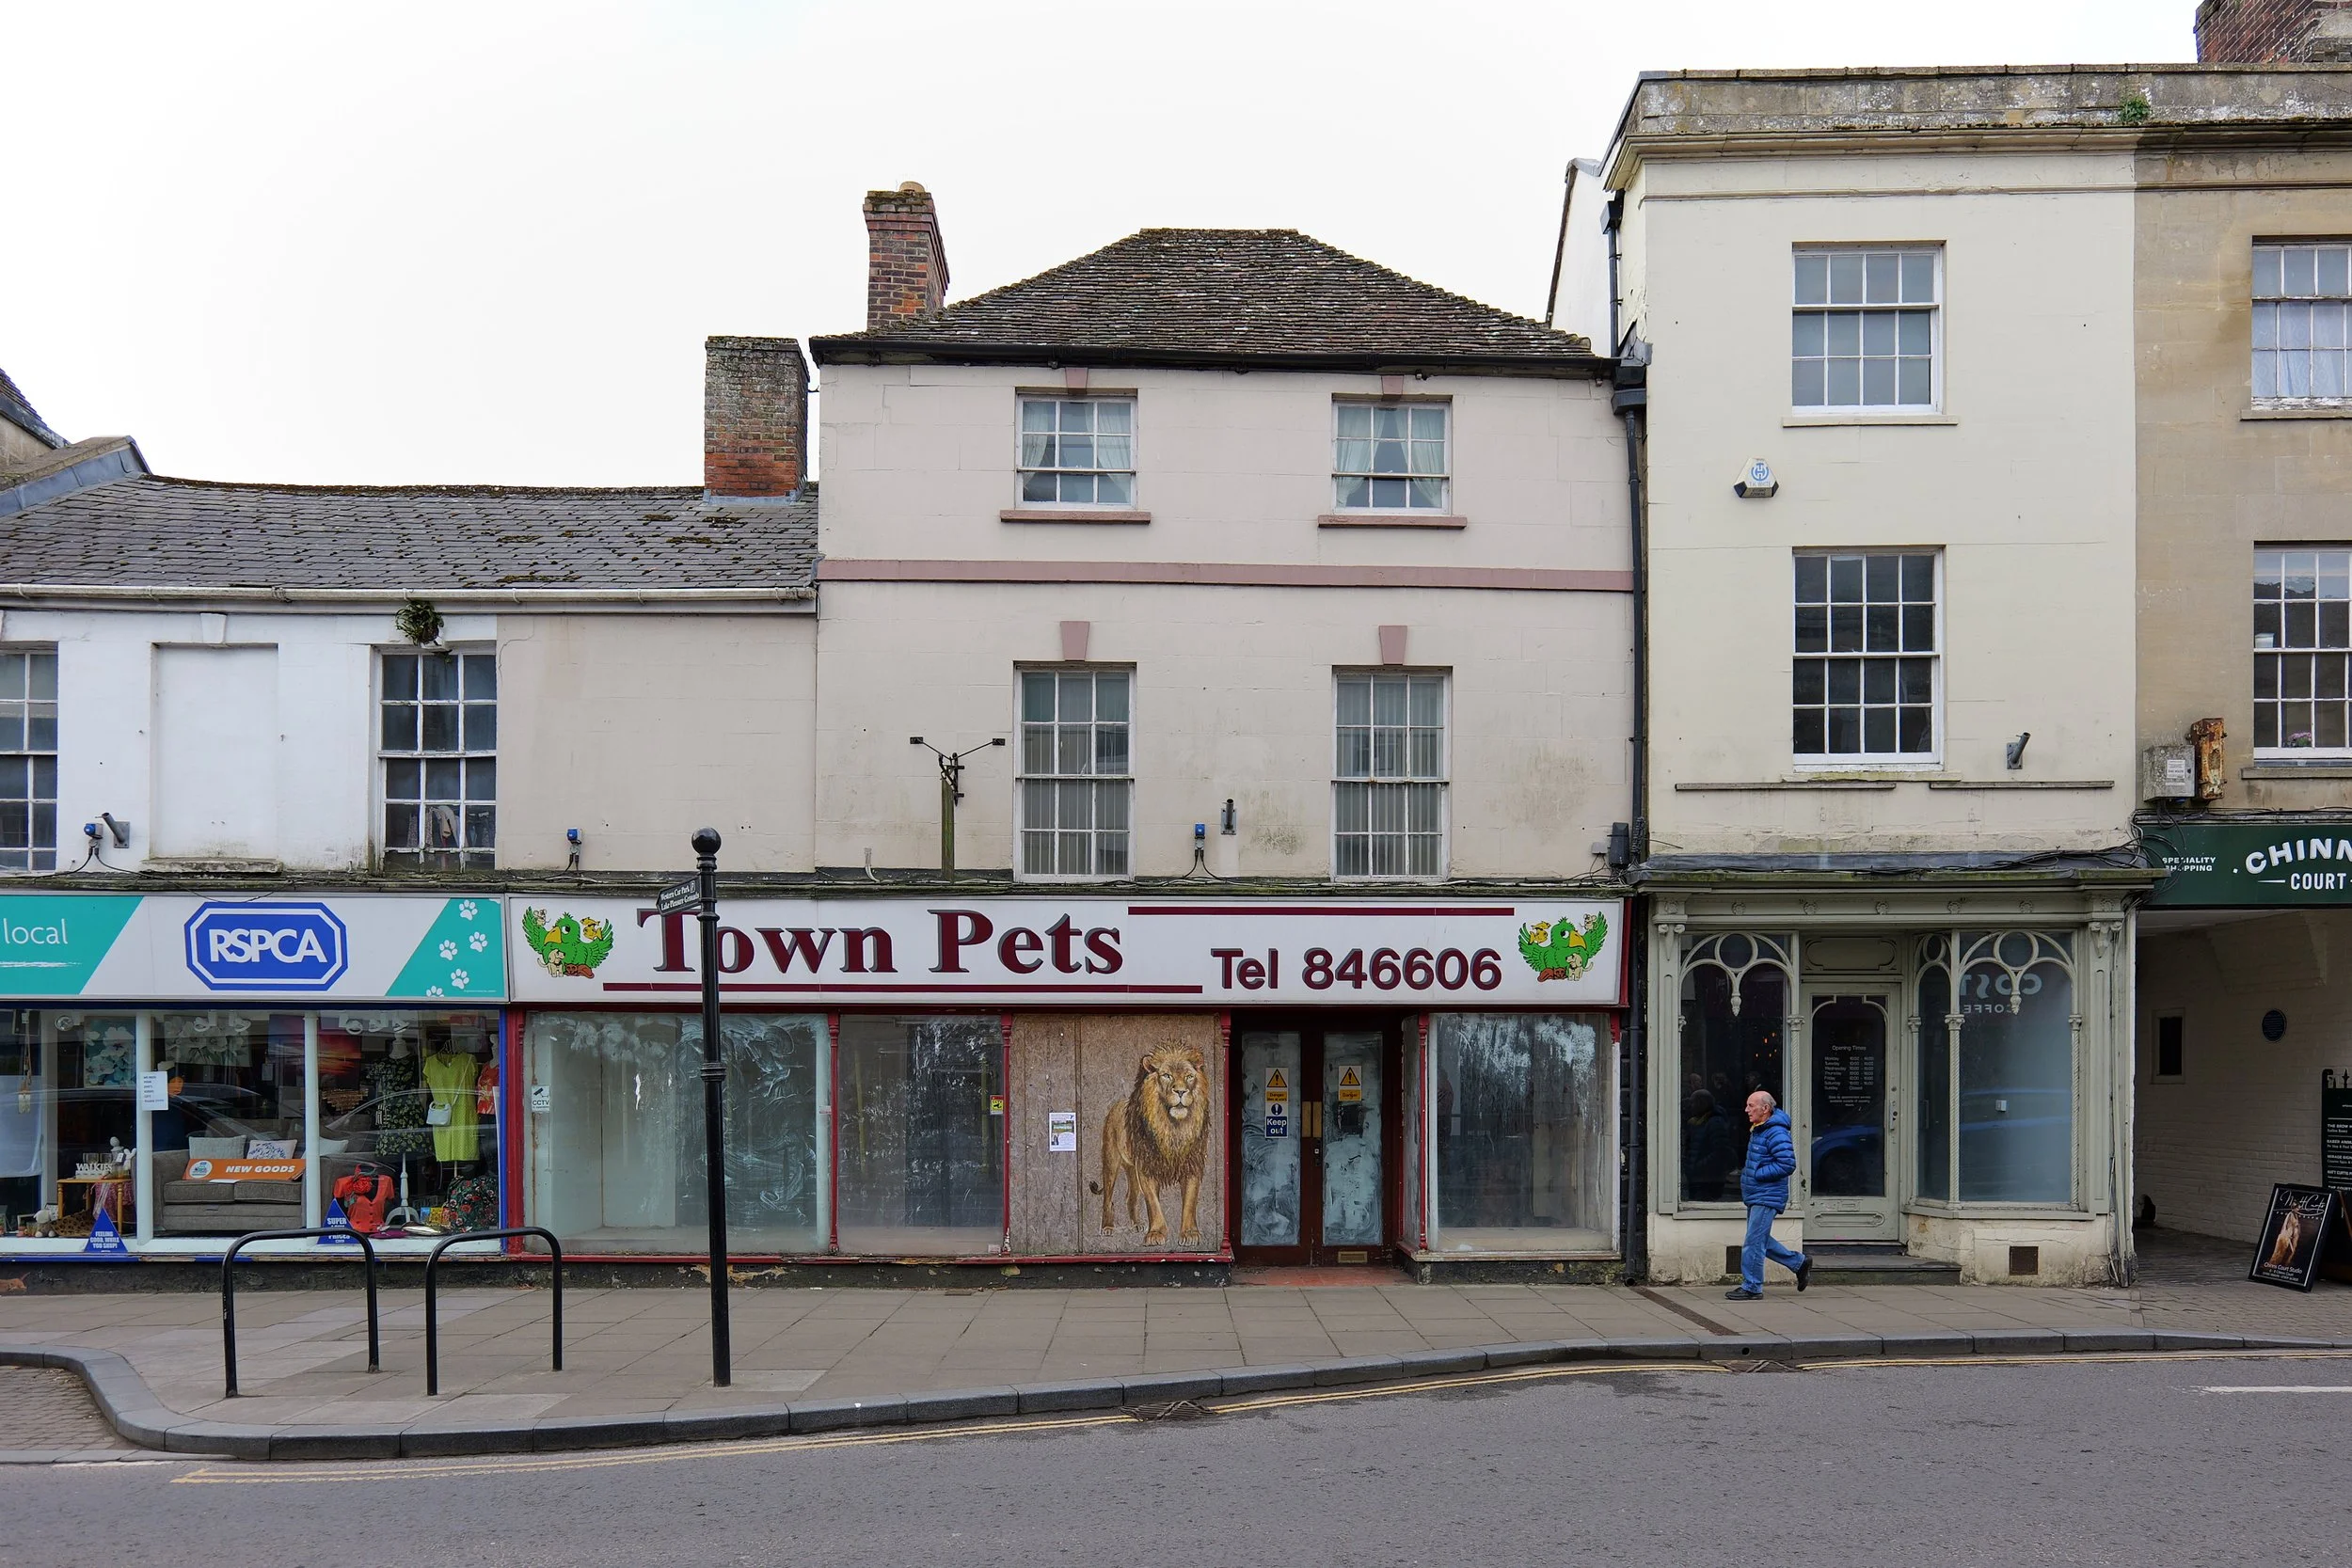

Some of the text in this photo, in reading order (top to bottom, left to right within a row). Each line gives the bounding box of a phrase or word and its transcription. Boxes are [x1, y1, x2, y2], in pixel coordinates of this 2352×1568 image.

[2290, 872, 2347, 890] COURT
[3, 918, 69, 945] local
[637, 908, 1123, 974] Town Pets
[209, 928, 328, 963] RSPCA
[1210, 947, 1502, 991] Tel 846606
[1266, 1118, 1287, 1128] Keep
[76, 1163, 113, 1172] WALKIES
